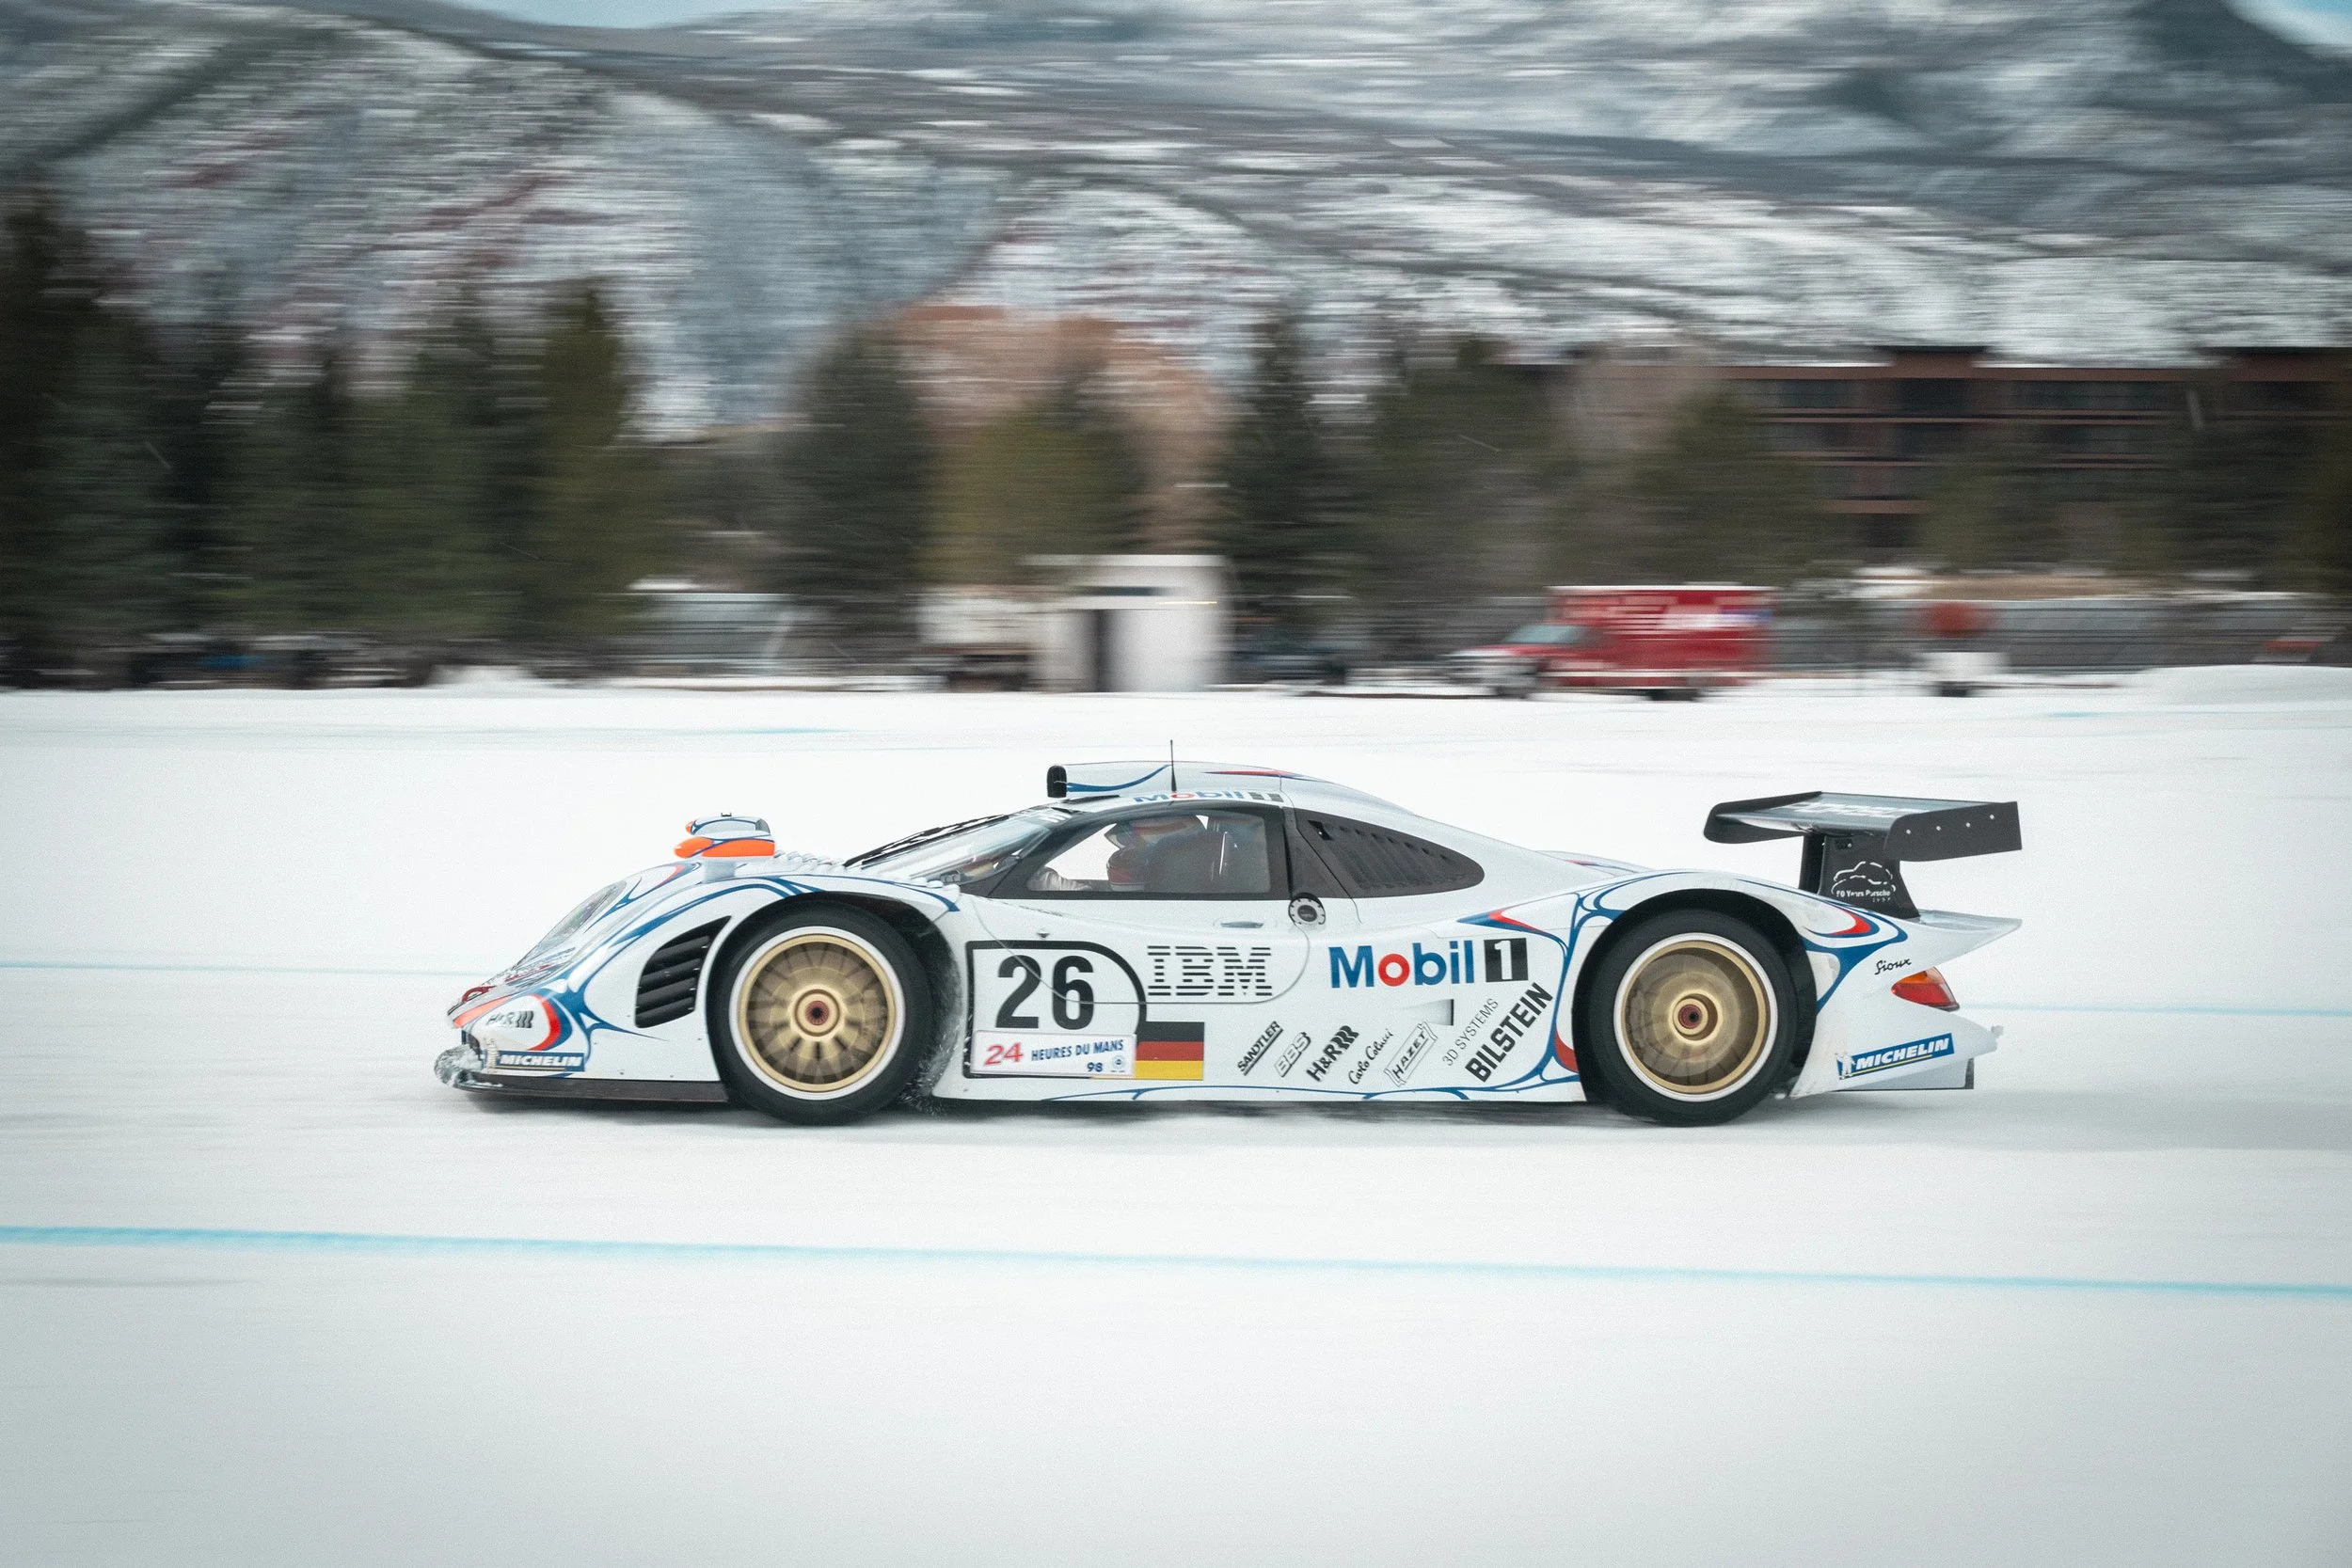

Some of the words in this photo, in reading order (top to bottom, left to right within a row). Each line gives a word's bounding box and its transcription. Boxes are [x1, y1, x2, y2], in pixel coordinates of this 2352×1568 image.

[1133, 791, 1245, 802] Mobil
[1147, 945, 1273, 996] IBM
[1328, 941, 1474, 988] Mobil
[1874, 958, 1912, 975] Sioux
[995, 955, 1094, 1030] 26
[984, 1042, 1024, 1066] 24
[1031, 1046, 1072, 1061] HEURES
[1075, 1043, 1090, 1055] DU
[1093, 1039, 1123, 1053] MANS
[1237, 1021, 1280, 1072] SANDTLER
[1274, 1031, 1311, 1078] BBS
[1392, 1031, 1426, 1079] HAZET
[1442, 1049, 1459, 1067] 3D
[1454, 998, 1499, 1050] SYSTEMS
[1465, 982, 1553, 1083] BILSTEIN
[1855, 1037, 1949, 1070] MICHELIN
[500, 1054, 583, 1067] MICHELIN
[1087, 1062, 1104, 1072] 98
[1348, 1061, 1370, 1085] Carlo
